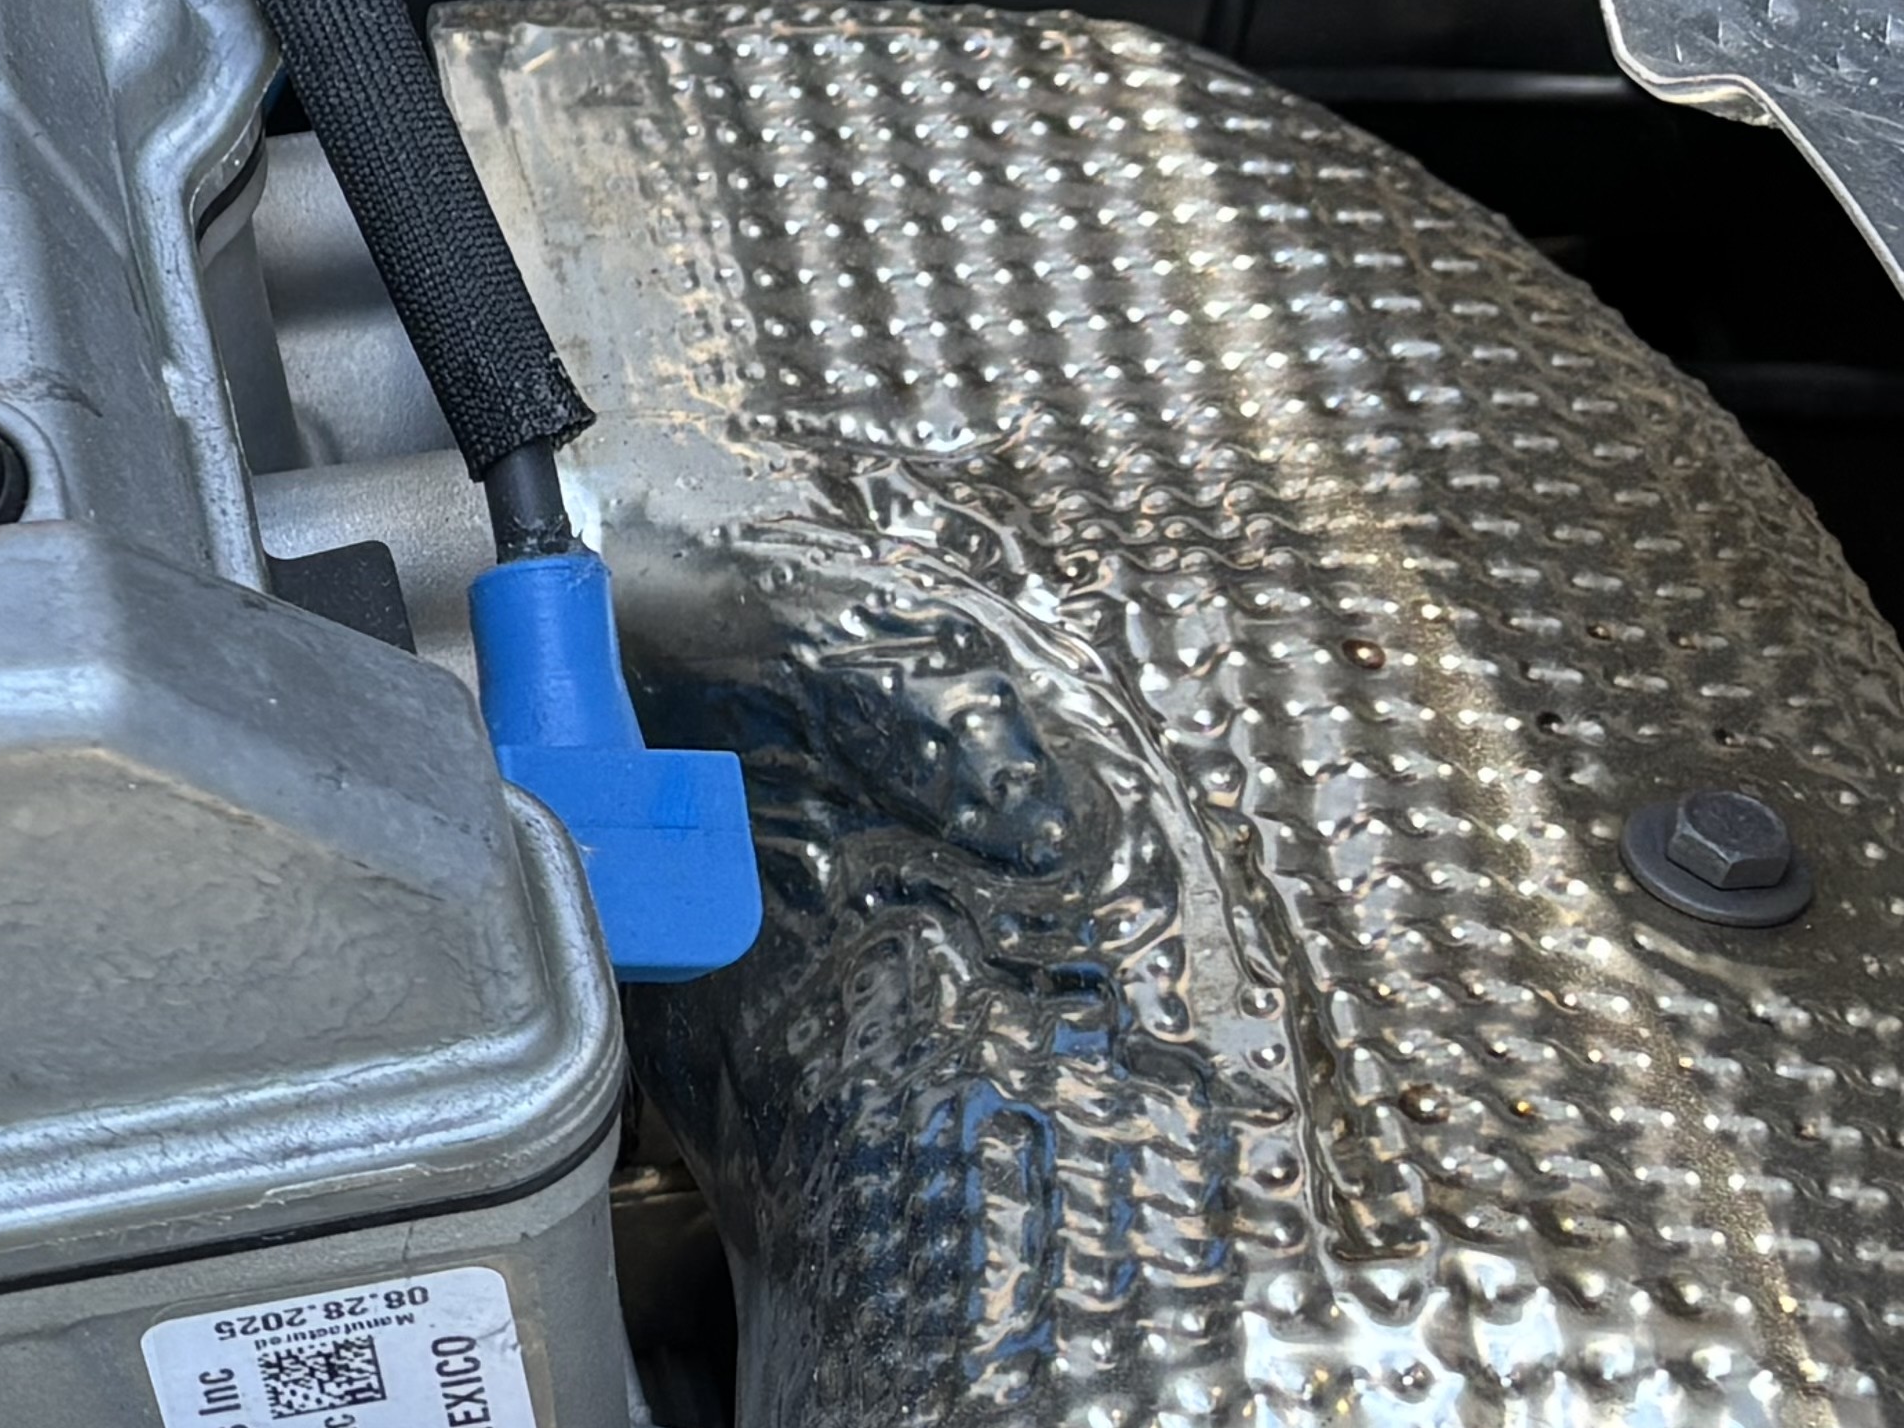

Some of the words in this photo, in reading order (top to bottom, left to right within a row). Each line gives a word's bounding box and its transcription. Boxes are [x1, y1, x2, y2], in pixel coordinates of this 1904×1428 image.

[215, 1287, 429, 1341] 08.28.2025
[254, 1314, 415, 1350] Manufactured
[199, 1368, 241, 1416] Inc
